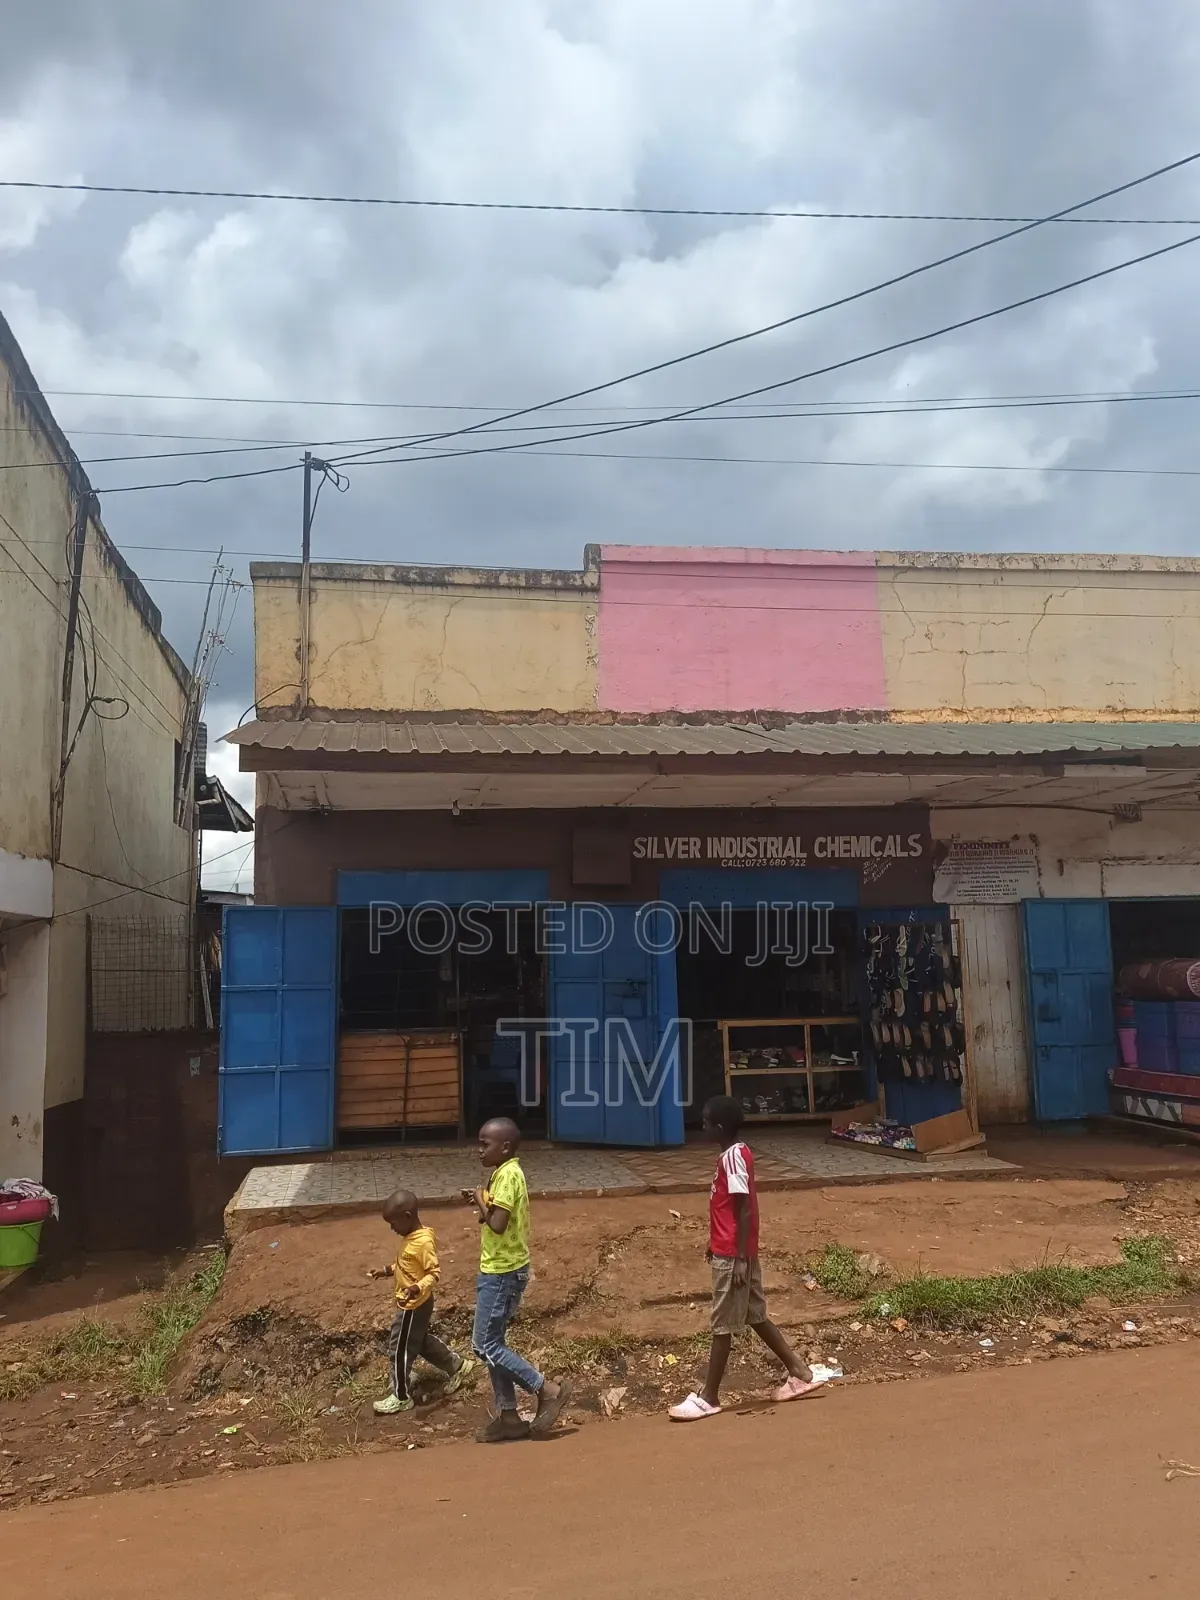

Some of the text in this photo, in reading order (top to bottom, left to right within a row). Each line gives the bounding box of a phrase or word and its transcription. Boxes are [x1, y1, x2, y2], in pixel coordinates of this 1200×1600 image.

[632, 834, 923, 859] SILVER INDUSTRIAL CHEMICALS
[769, 859, 786, 867] 680
[789, 859, 806, 867] 922
